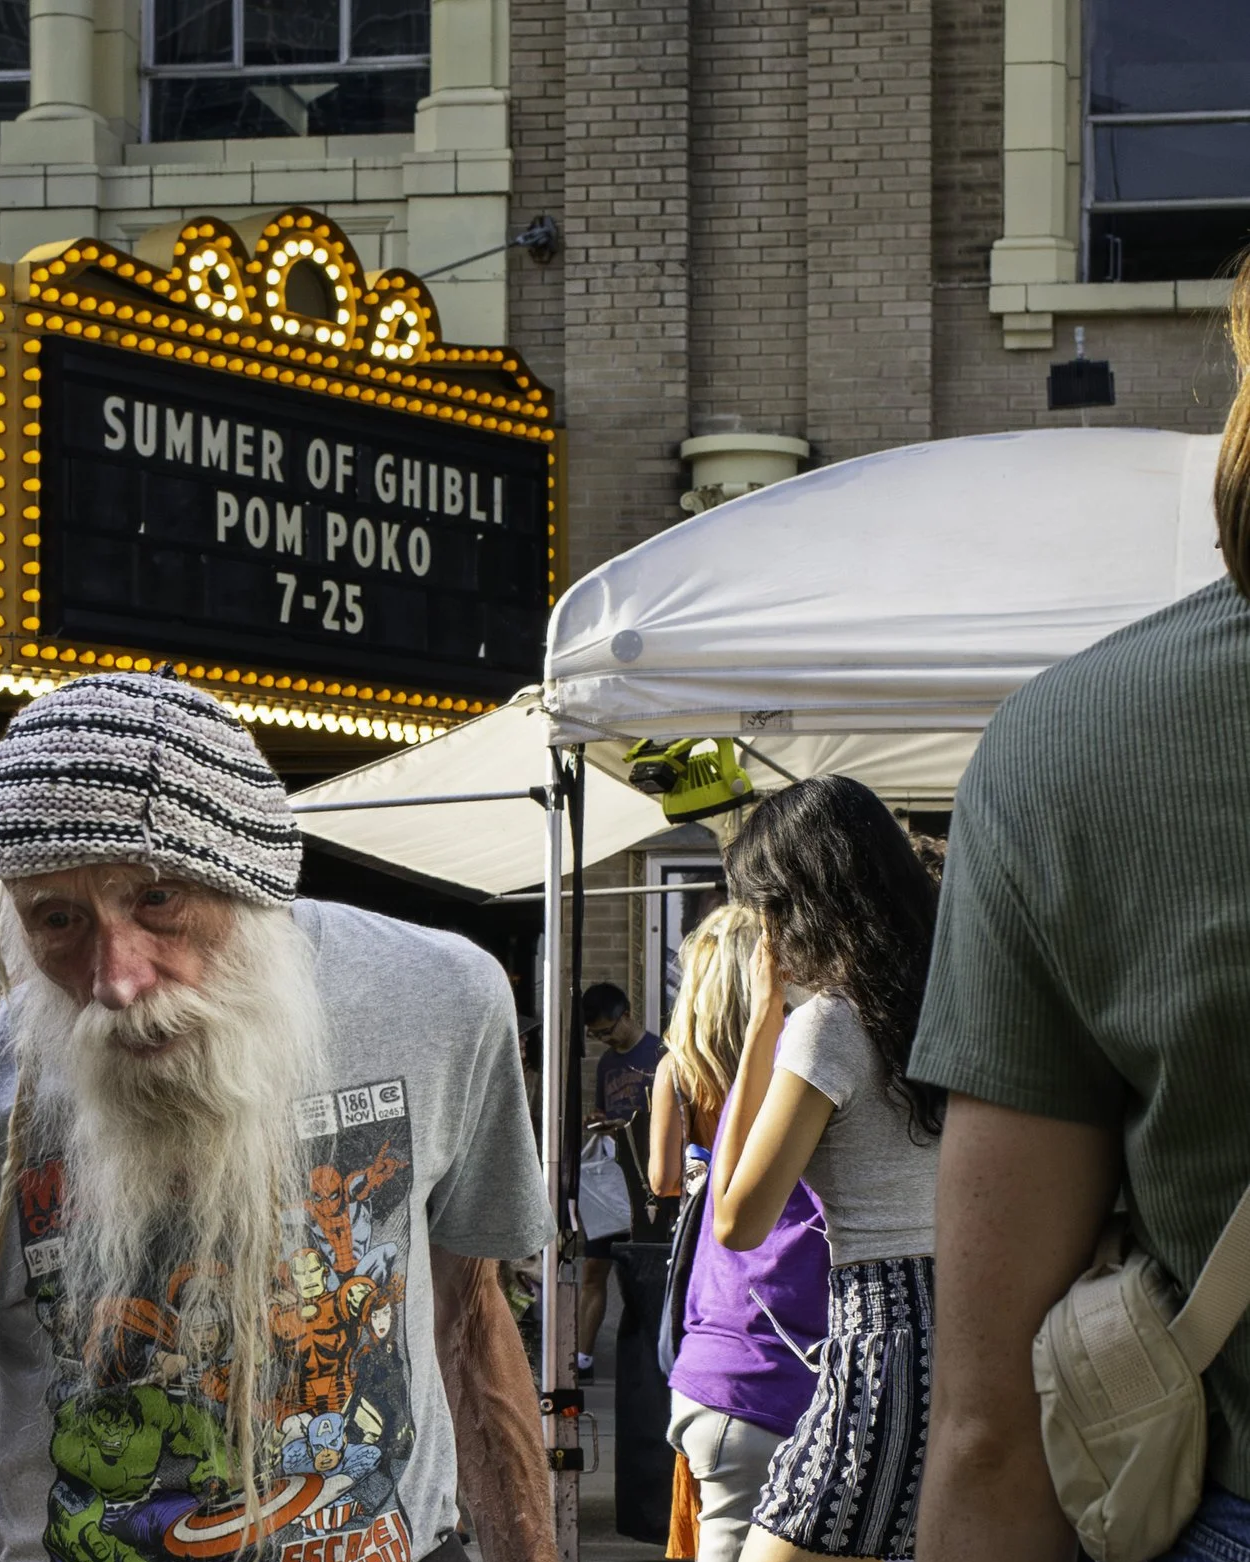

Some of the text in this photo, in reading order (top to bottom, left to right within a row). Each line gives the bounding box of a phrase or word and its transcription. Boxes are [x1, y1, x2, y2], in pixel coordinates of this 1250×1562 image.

[104, 396, 503, 524] SUMMER OF GHIBLI
[217, 492, 431, 577] POM POKO
[276, 572, 364, 634] 7-25
[341, 1092, 368, 1114] 186
[345, 1106, 405, 1124] NOV 02457
